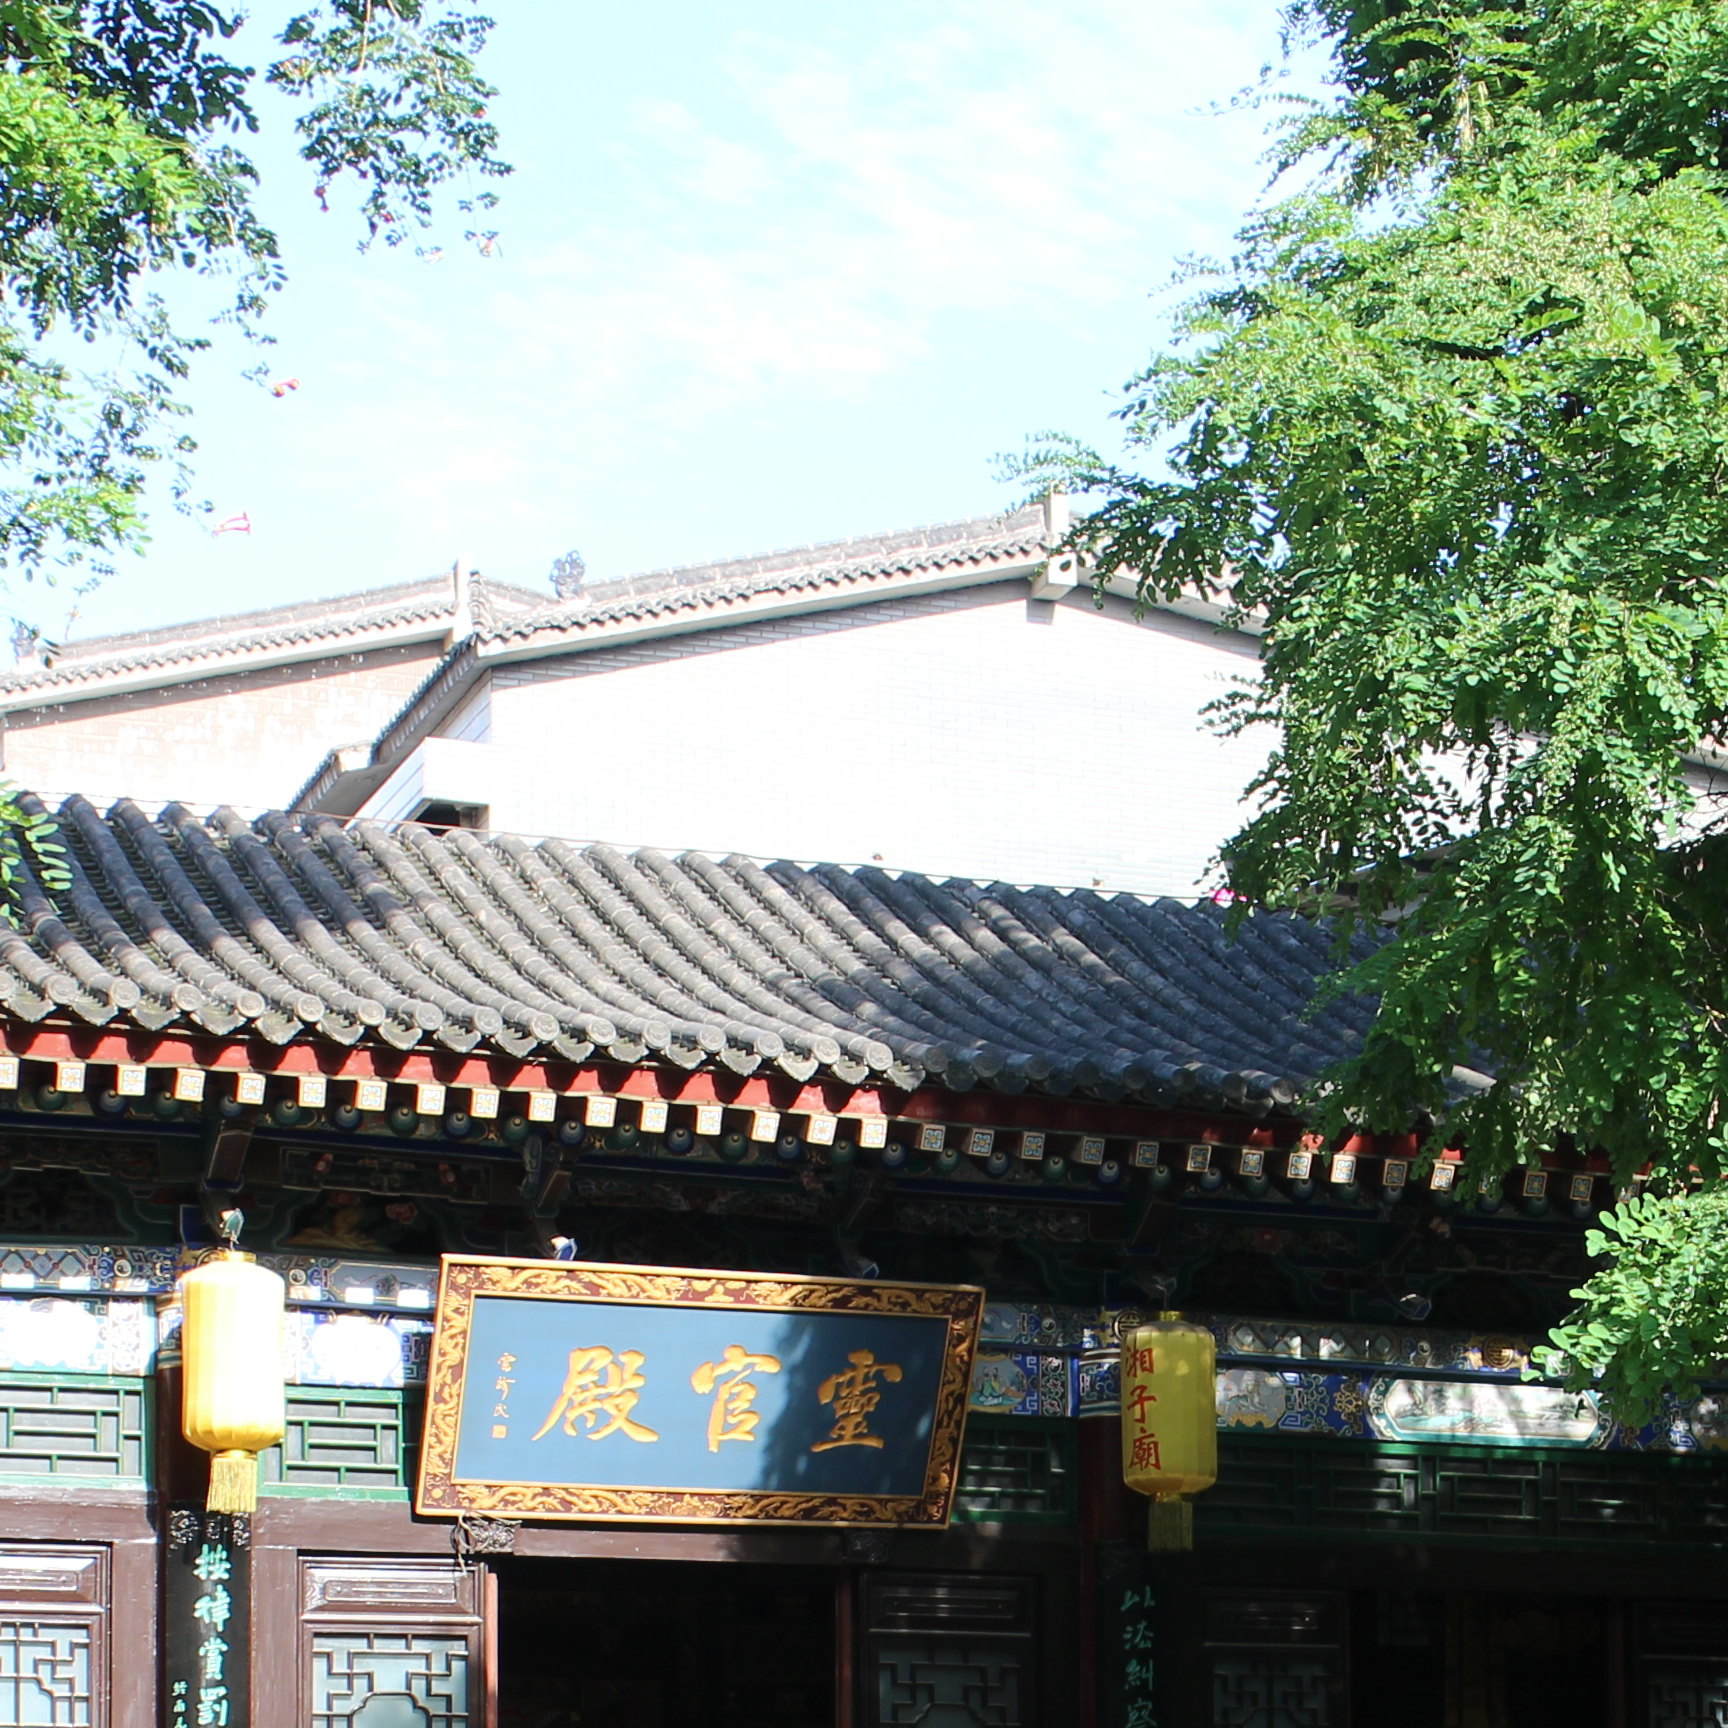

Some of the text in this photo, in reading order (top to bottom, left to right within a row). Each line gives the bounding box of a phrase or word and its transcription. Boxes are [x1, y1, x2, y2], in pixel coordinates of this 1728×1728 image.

[532, 1344, 903, 1454] 靈官殿
[1124, 1343, 1161, 1472] 湘子廟
